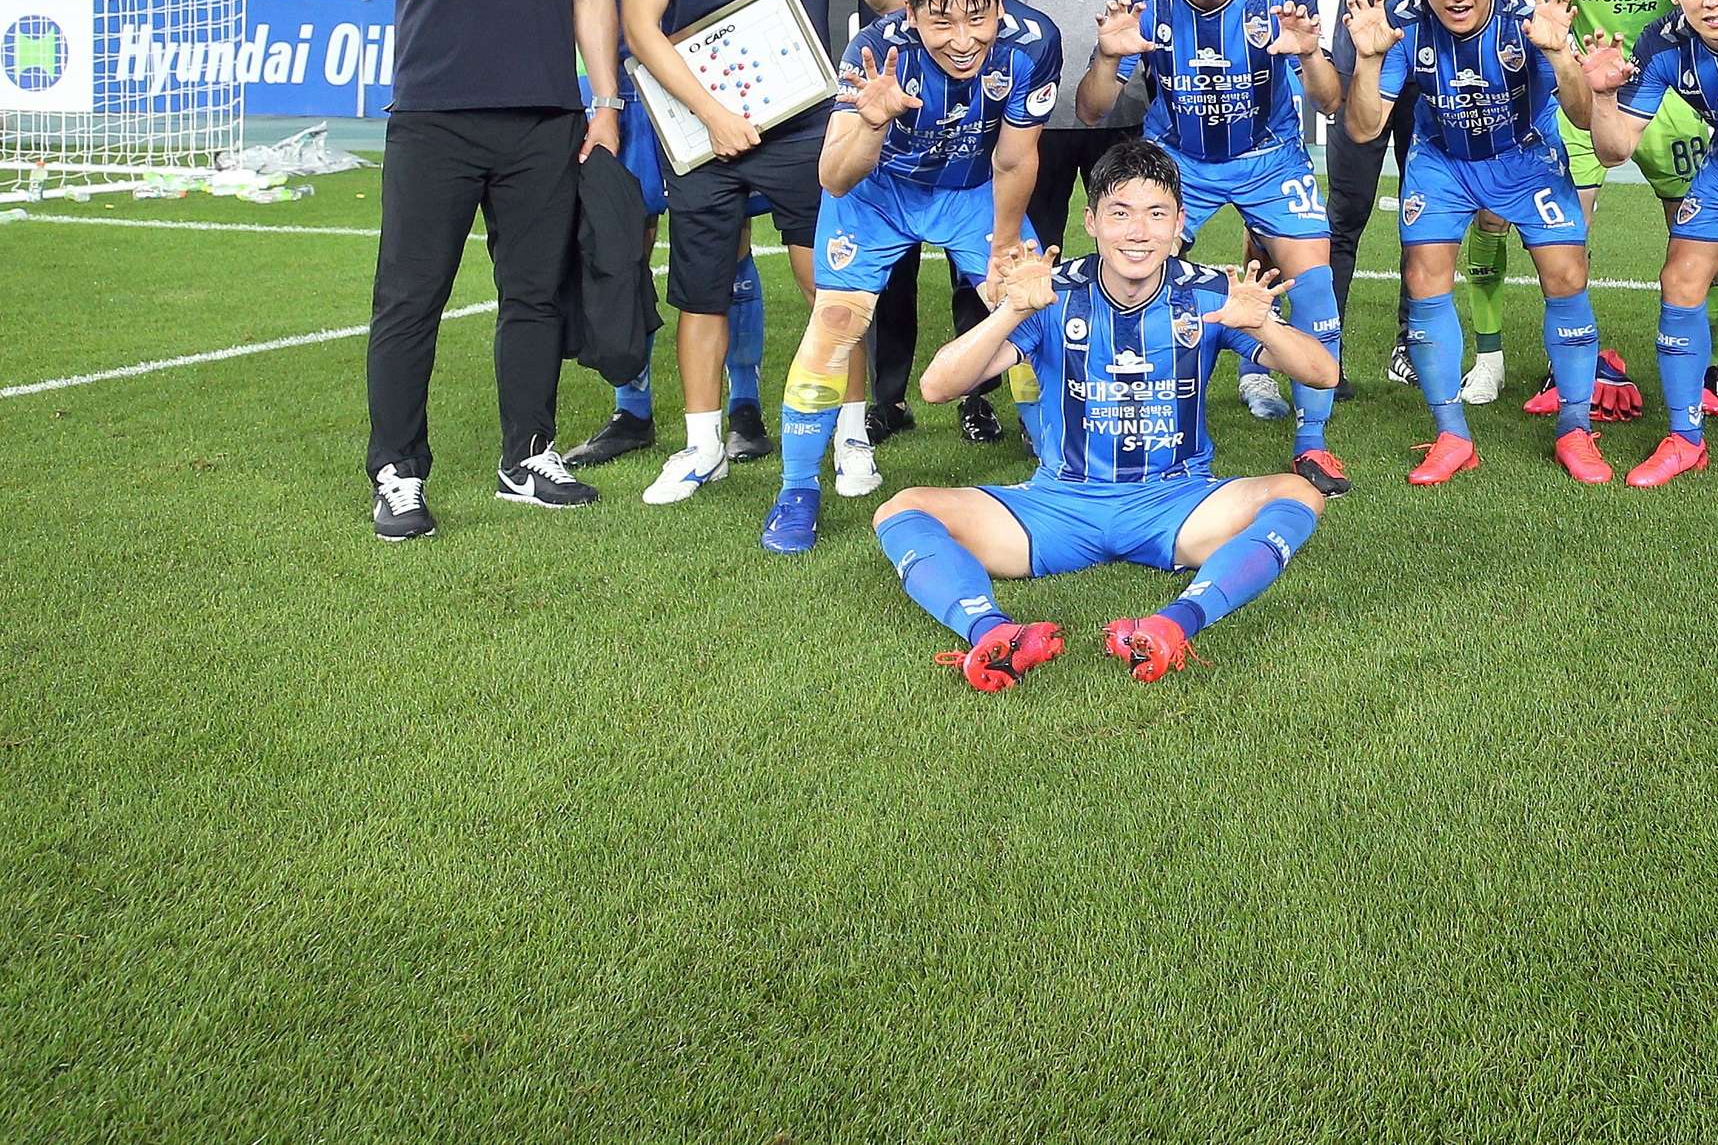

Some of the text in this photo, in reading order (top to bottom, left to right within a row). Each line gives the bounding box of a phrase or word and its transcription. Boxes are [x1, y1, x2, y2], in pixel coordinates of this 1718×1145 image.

[705, 24, 737, 45] CAPO
[114, 21, 315, 97] Hyundai
[1171, 101, 1252, 116] HYUNDAI
[1280, 176, 1326, 214] 32
[1533, 187, 1565, 225] 6
[1557, 325, 1595, 337] UHFC
[1067, 377, 1197, 403] 현대오일뱅크
[1090, 405, 1174, 419] 프리미엄 선박유
[1082, 417, 1175, 436] HYUNDAI
